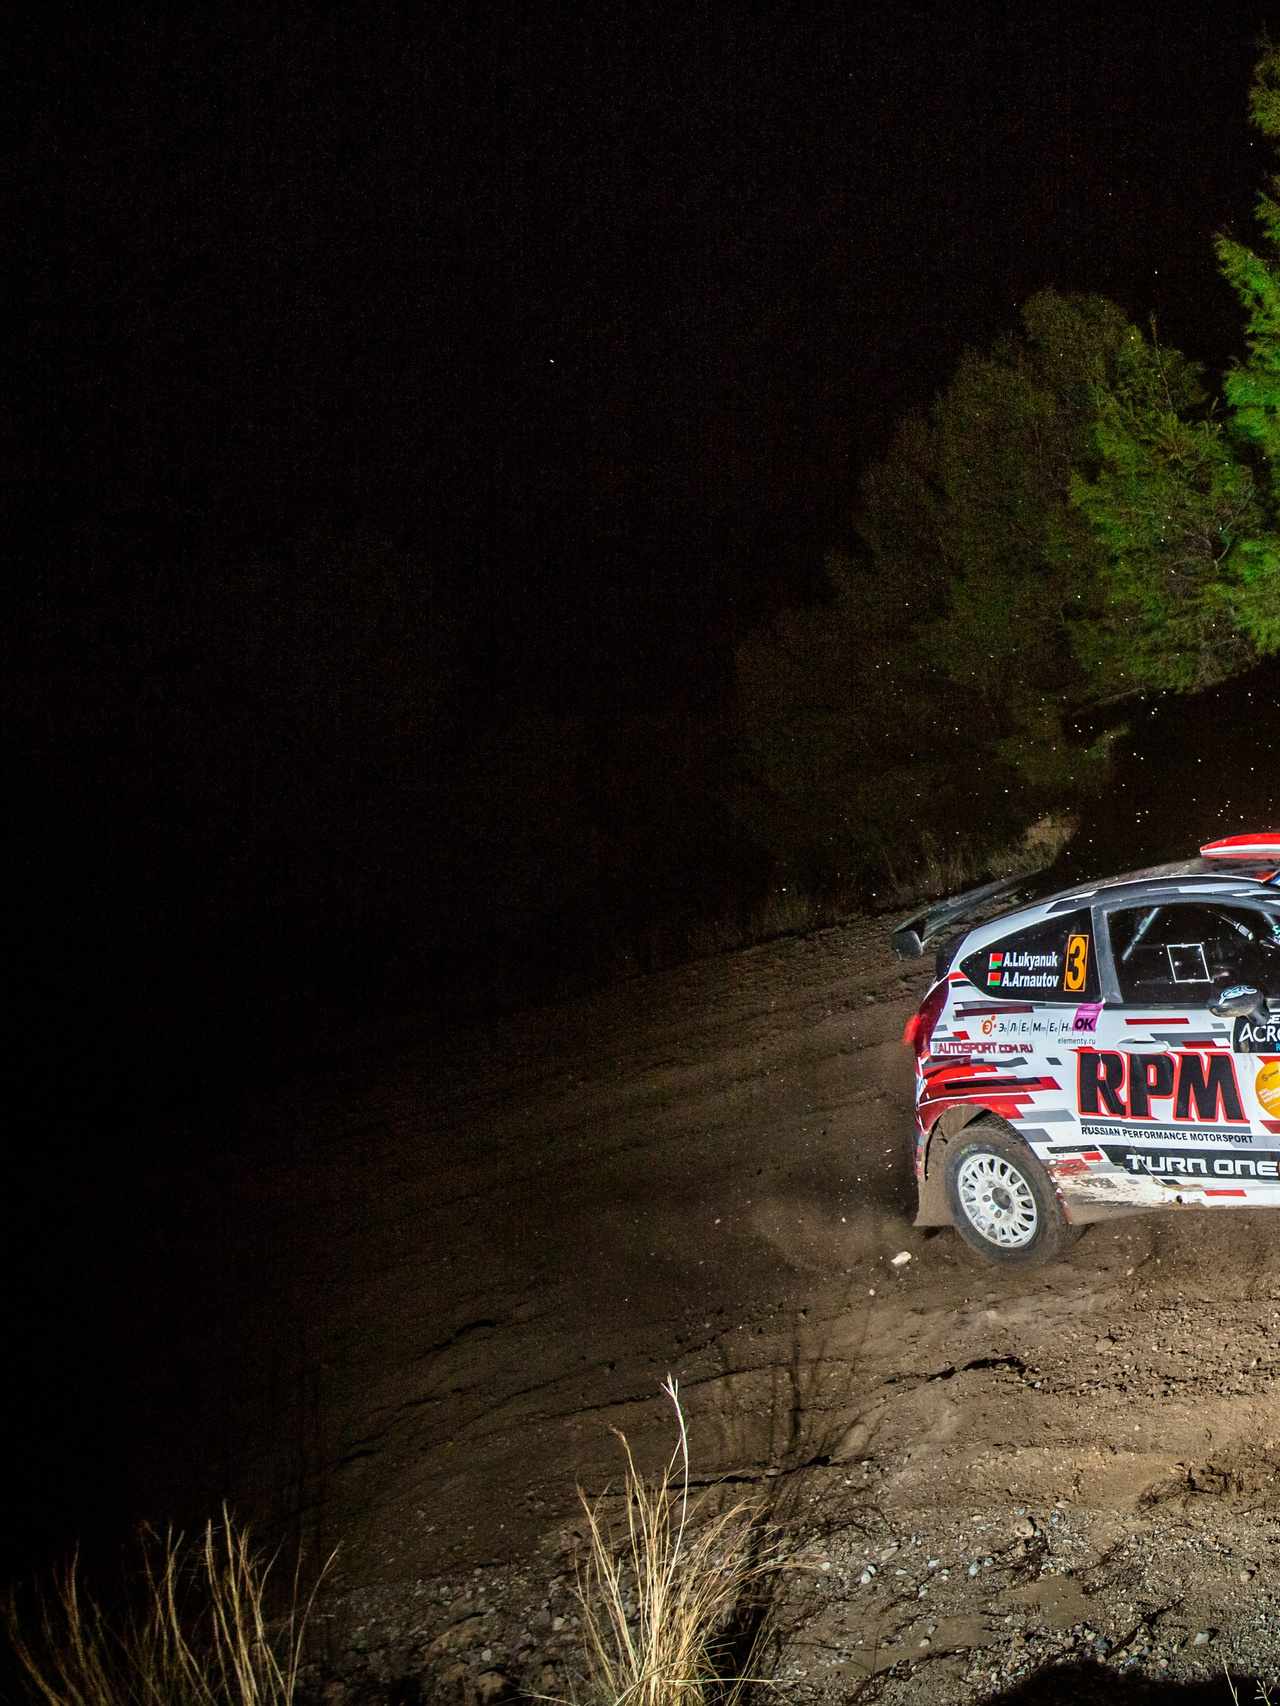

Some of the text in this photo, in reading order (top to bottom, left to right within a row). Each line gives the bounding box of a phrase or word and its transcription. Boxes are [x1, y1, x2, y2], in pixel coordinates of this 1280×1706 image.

[1003, 951, 1058, 970] A.Lukyanuk
[1066, 937, 1086, 990] 3
[1001, 972, 1059, 988] A.Arnautov
[1074, 1017, 1096, 1031] OK
[1057, 1036, 1096, 1045] elementy.ru
[1077, 1052, 1250, 1123] RPM
[1081, 1126, 1253, 1144] RUSSIAN PERFORMANCE MOTORSPORT
[1126, 1154, 1279, 1177] TURN ONE
